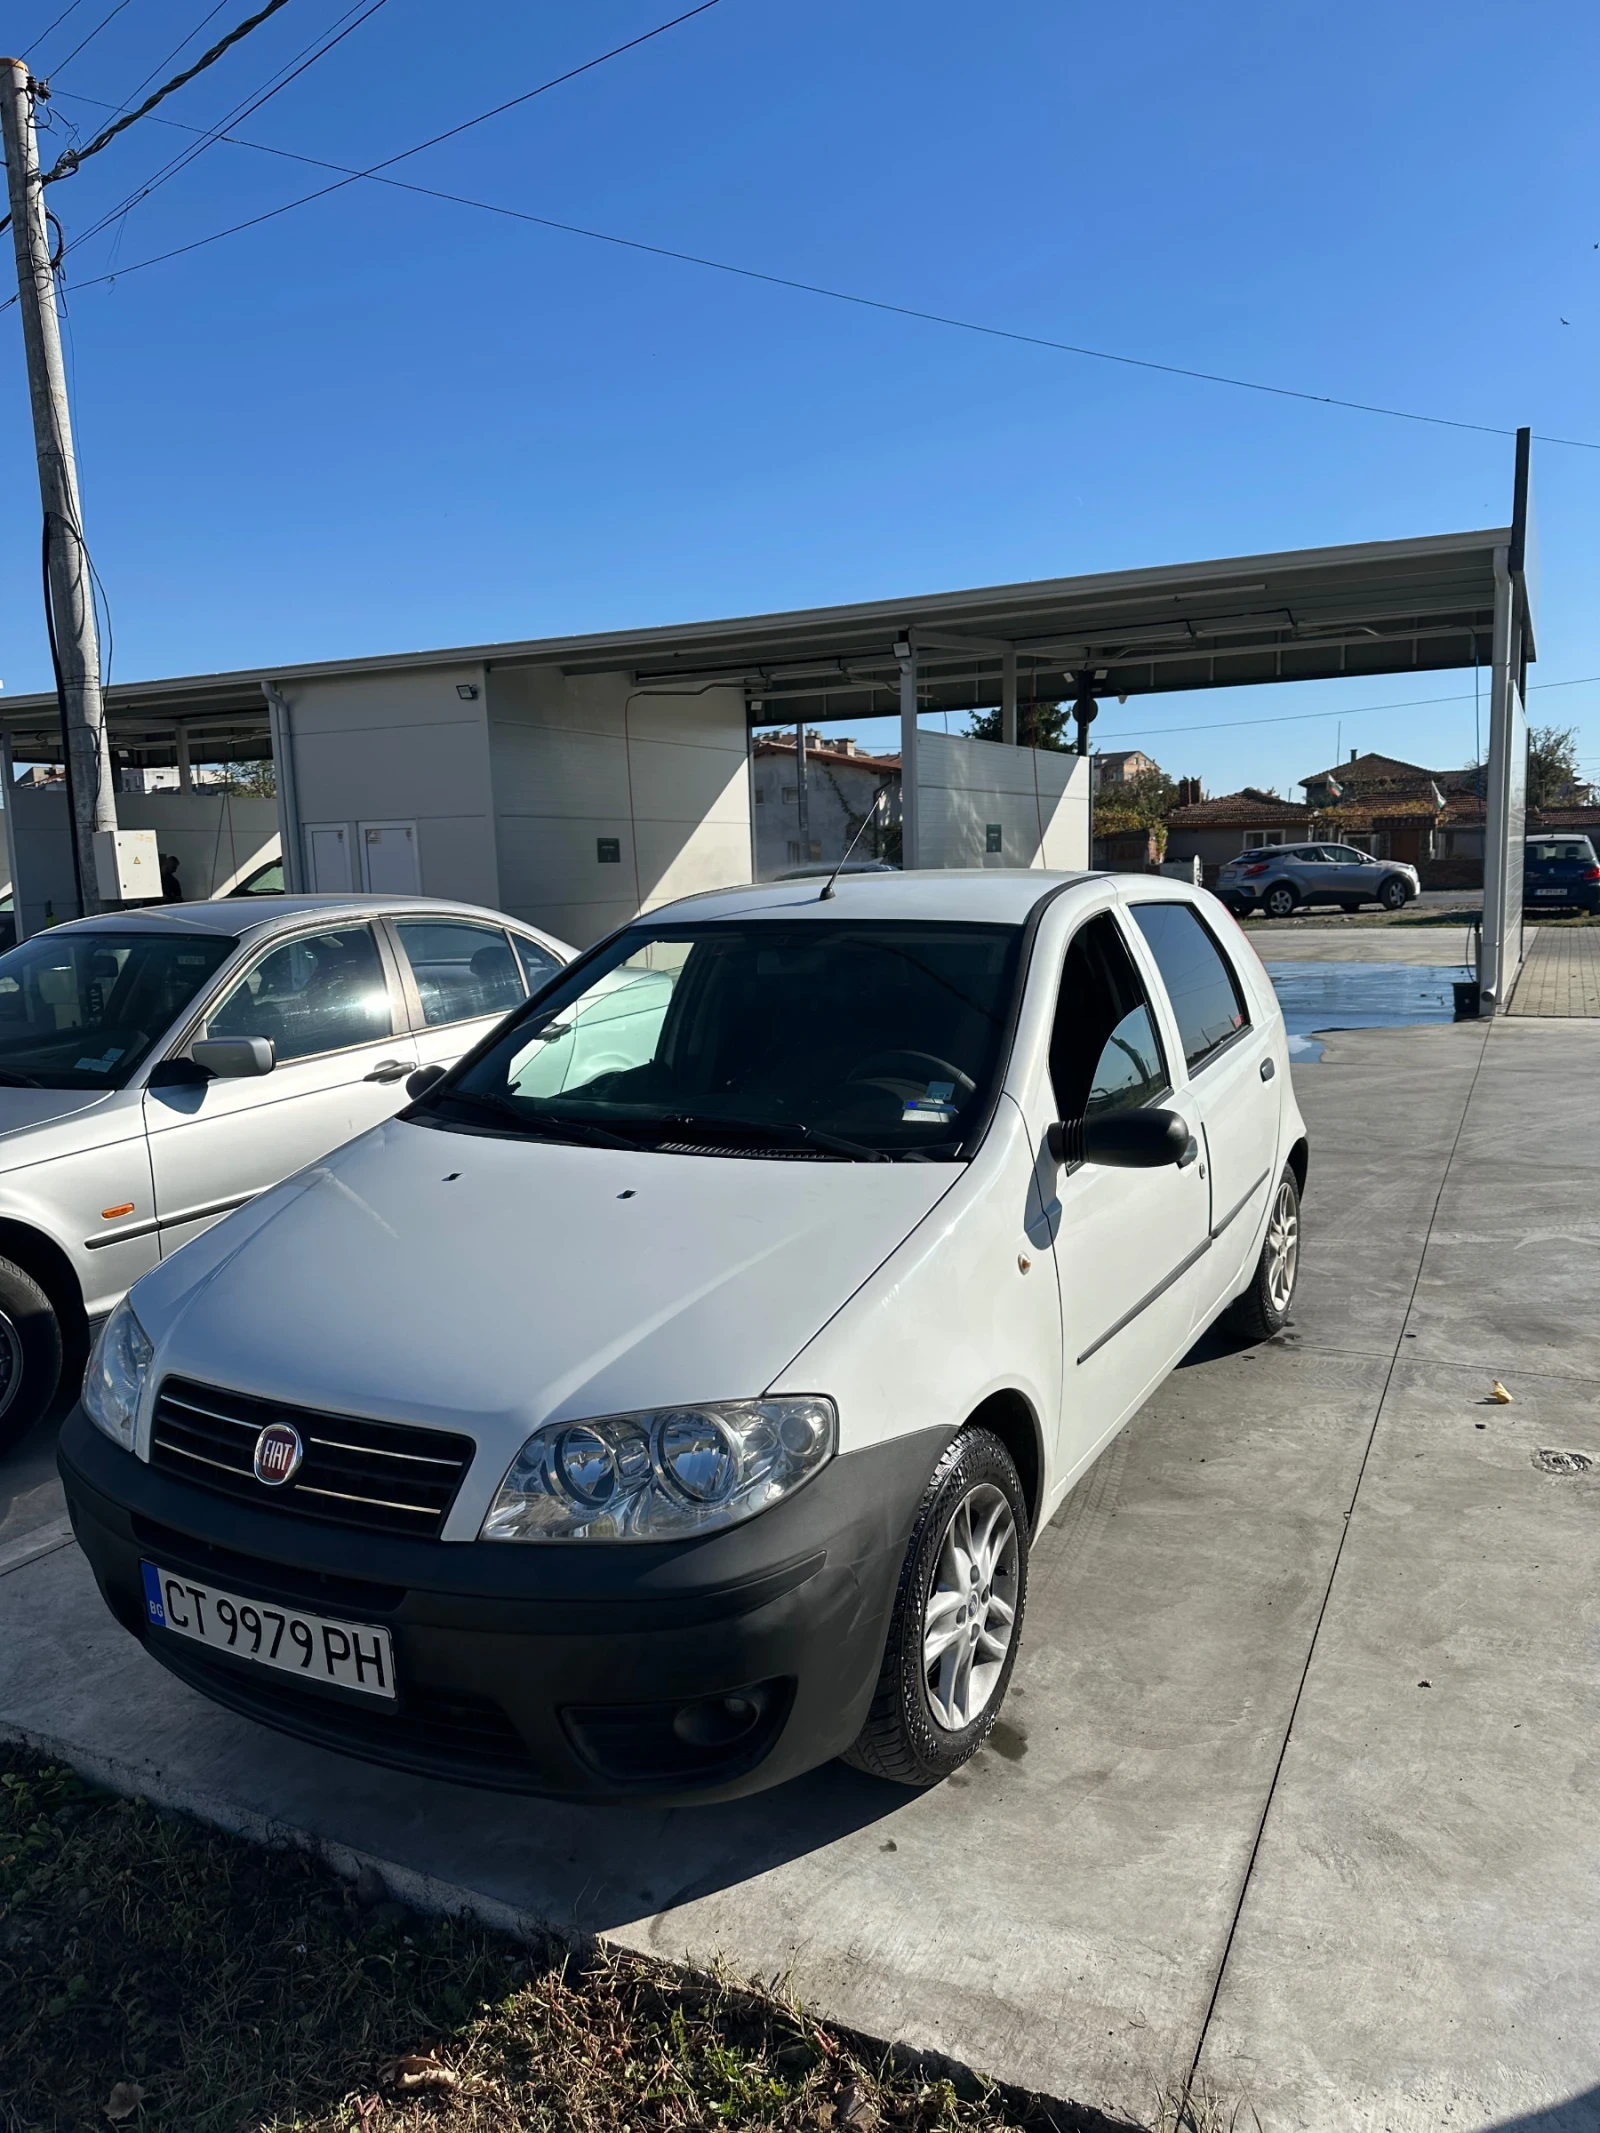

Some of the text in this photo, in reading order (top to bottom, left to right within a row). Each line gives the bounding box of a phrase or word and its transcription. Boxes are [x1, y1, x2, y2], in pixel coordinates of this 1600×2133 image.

[262, 1439, 293, 1471] FIAT
[149, 1600, 164, 1618] BG
[165, 1579, 386, 1688] CT 9979 PH
